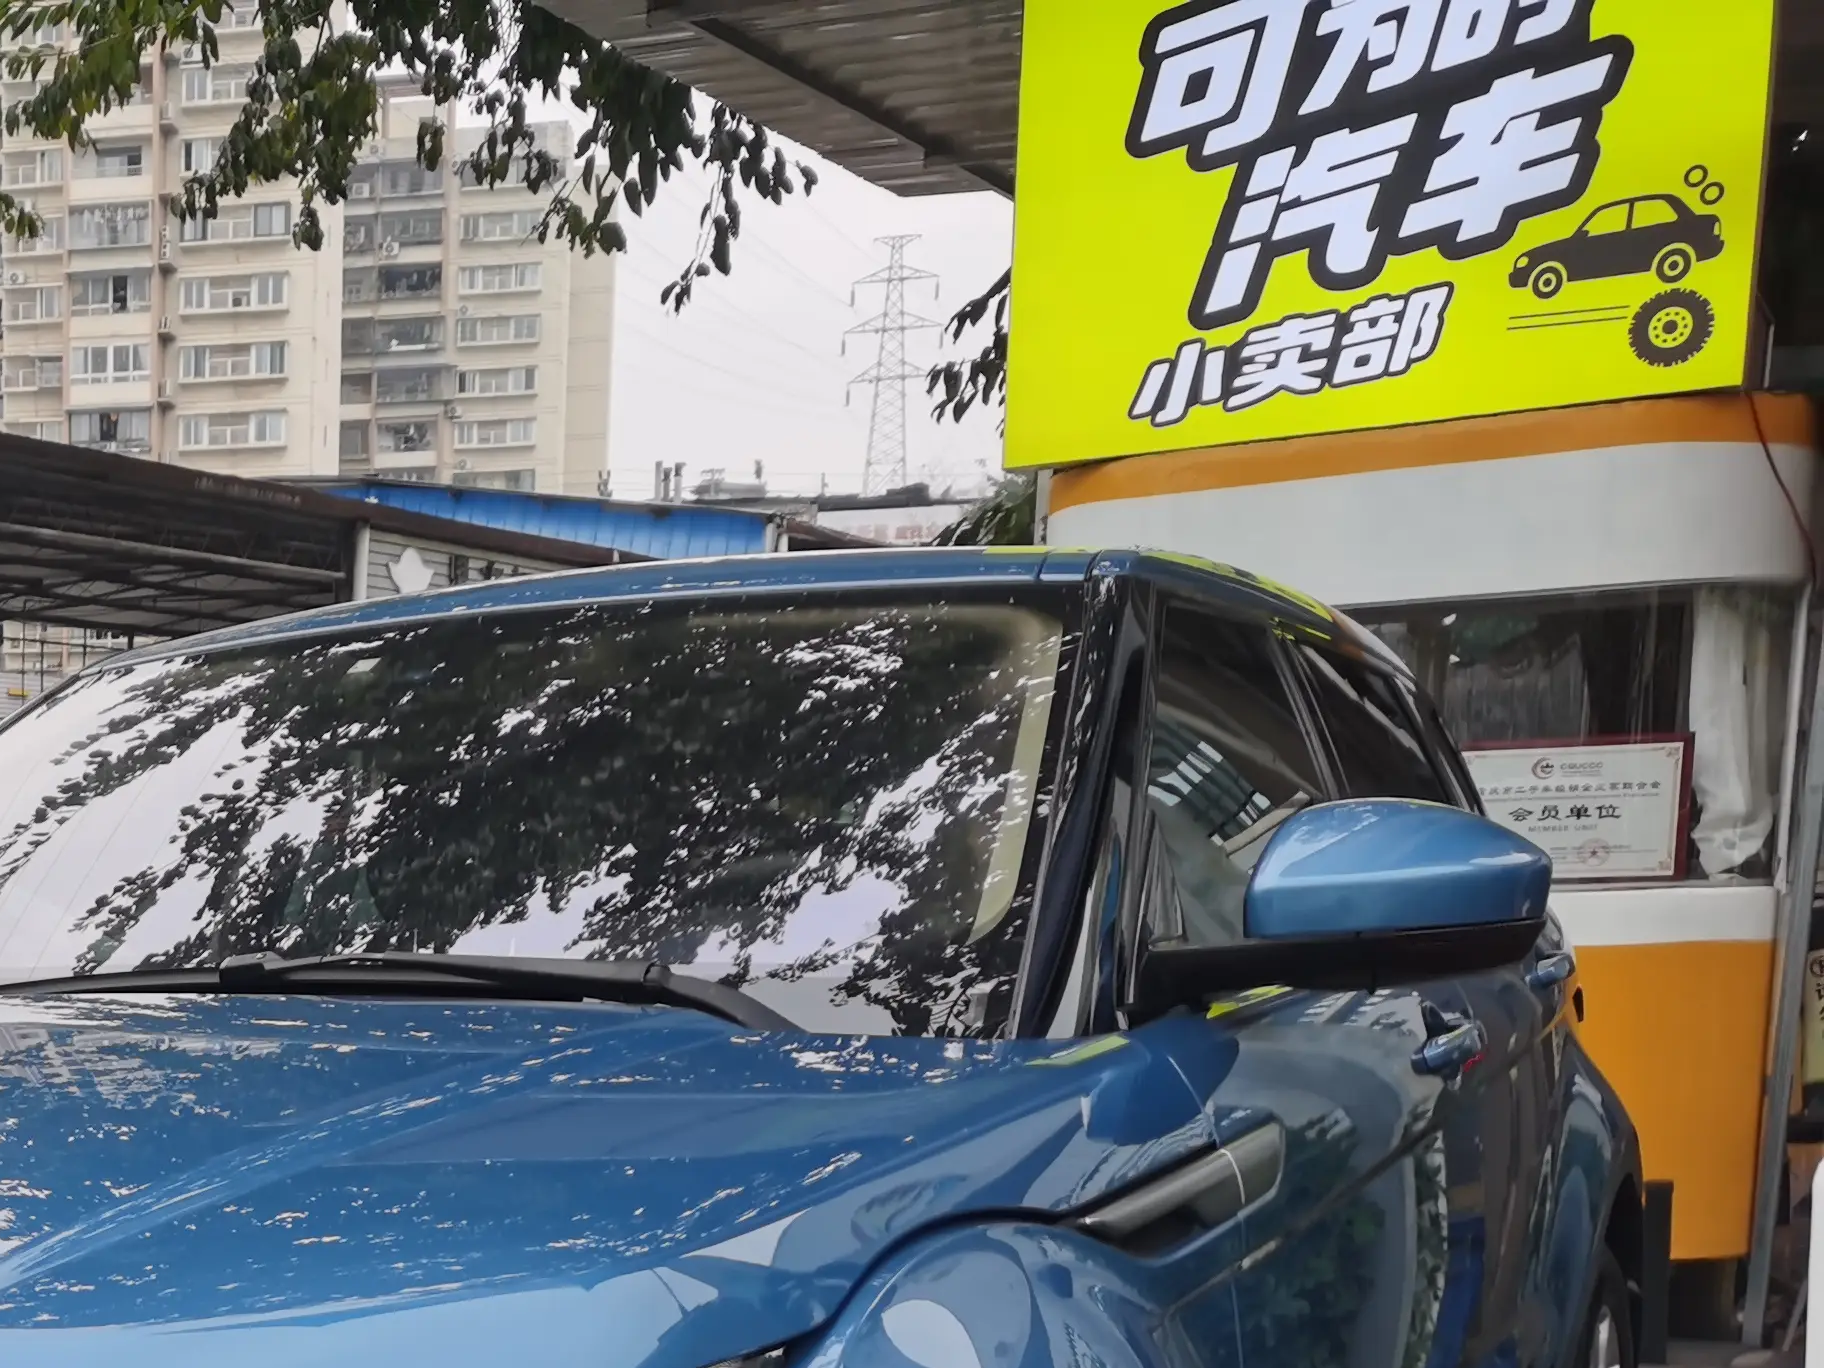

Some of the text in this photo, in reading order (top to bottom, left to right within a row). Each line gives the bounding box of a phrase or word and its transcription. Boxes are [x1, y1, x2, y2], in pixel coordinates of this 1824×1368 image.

[1204, 54, 1613, 315] 汽车
[1133, 296, 1444, 423] 小卖部
[1508, 803, 1622, 823] 会员单位
